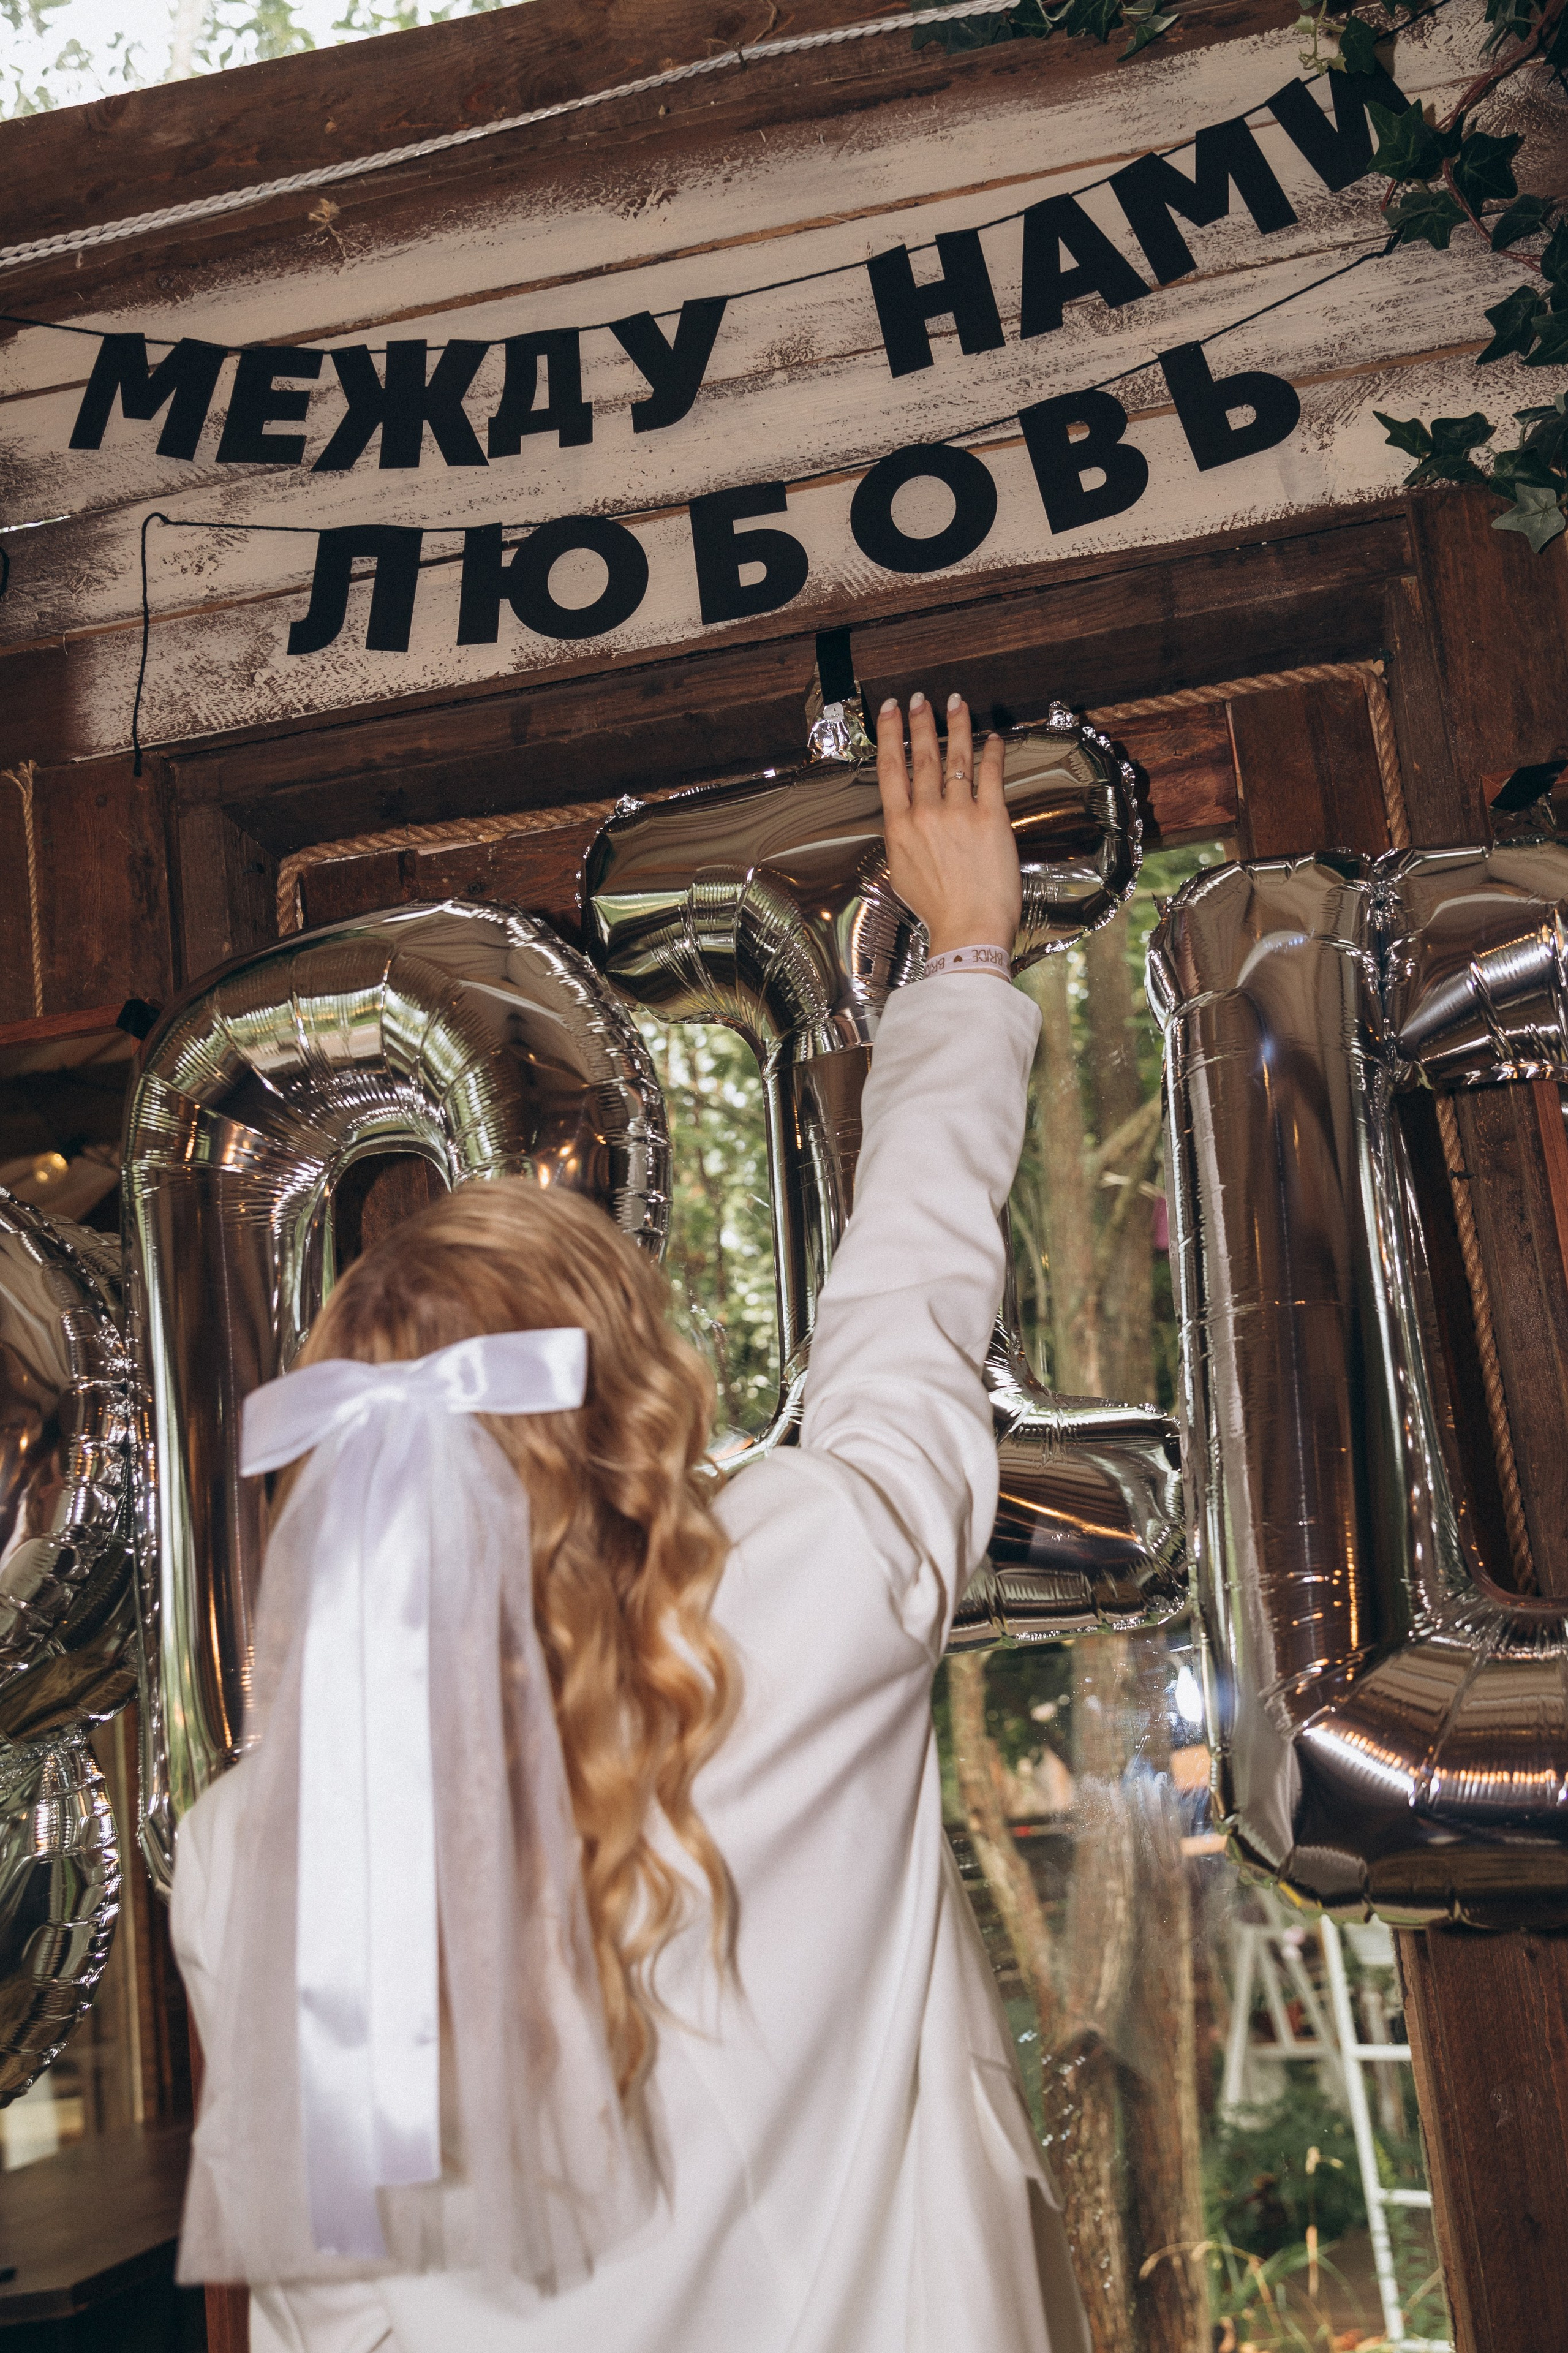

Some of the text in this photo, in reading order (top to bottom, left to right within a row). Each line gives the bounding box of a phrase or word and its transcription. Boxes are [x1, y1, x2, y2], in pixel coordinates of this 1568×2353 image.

[68, 55, 1412, 472] МЕЖДУ НАМИ
[287, 341, 1302, 655] ЛЮБОВЬ
[971, 949, 1003, 967] BRIDE
